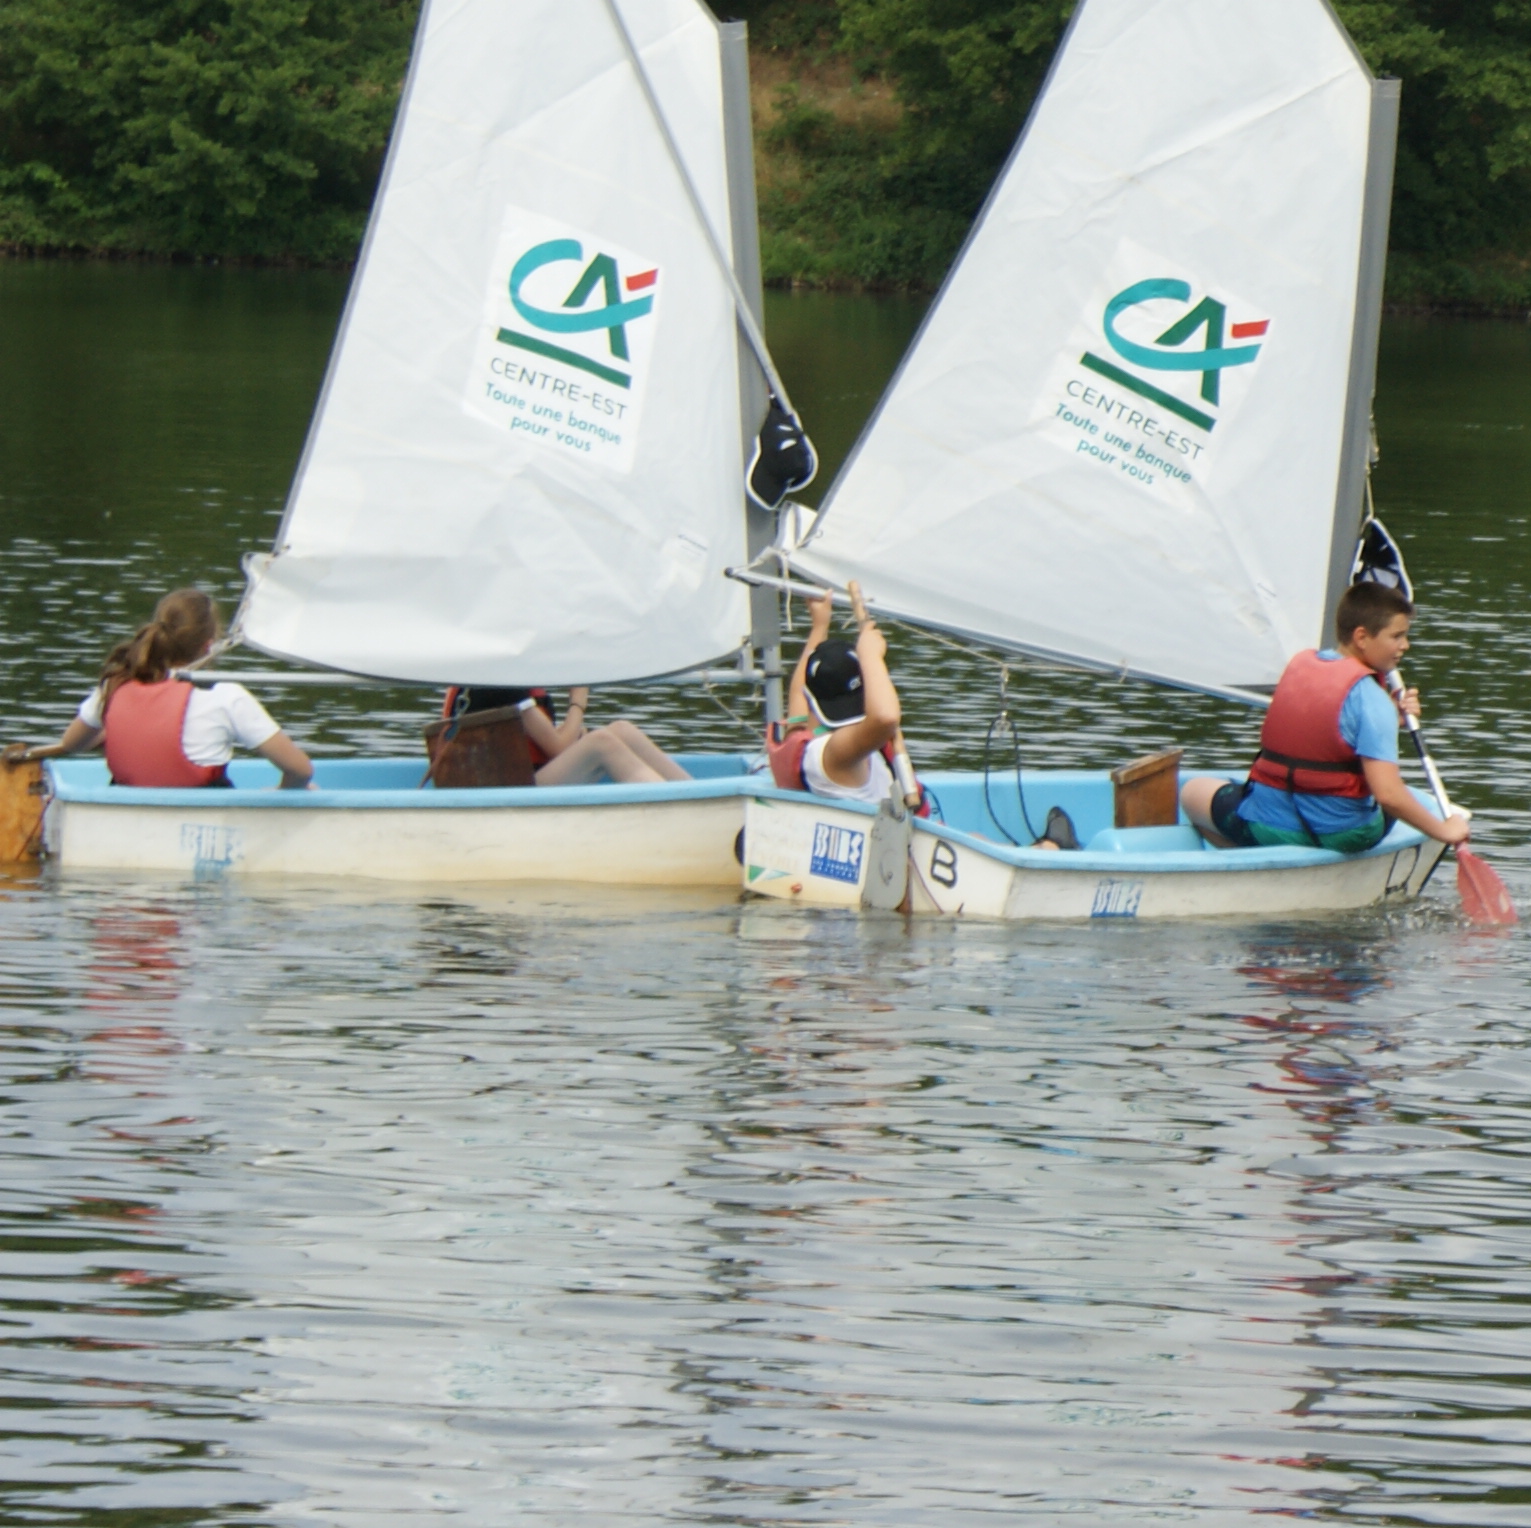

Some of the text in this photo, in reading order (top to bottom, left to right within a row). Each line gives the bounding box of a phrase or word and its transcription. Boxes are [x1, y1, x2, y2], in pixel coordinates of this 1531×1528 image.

[486, 382, 622, 445] Toute une banque
[490, 357, 628, 419] CENTRE-EST
[510, 415, 592, 452] pour vous
[1054, 403, 1192, 483] Toute une banque
[1066, 379, 1204, 460] CENTRE-EST
[1076, 438, 1154, 484] pour vous
[930, 840, 957, 889] B
